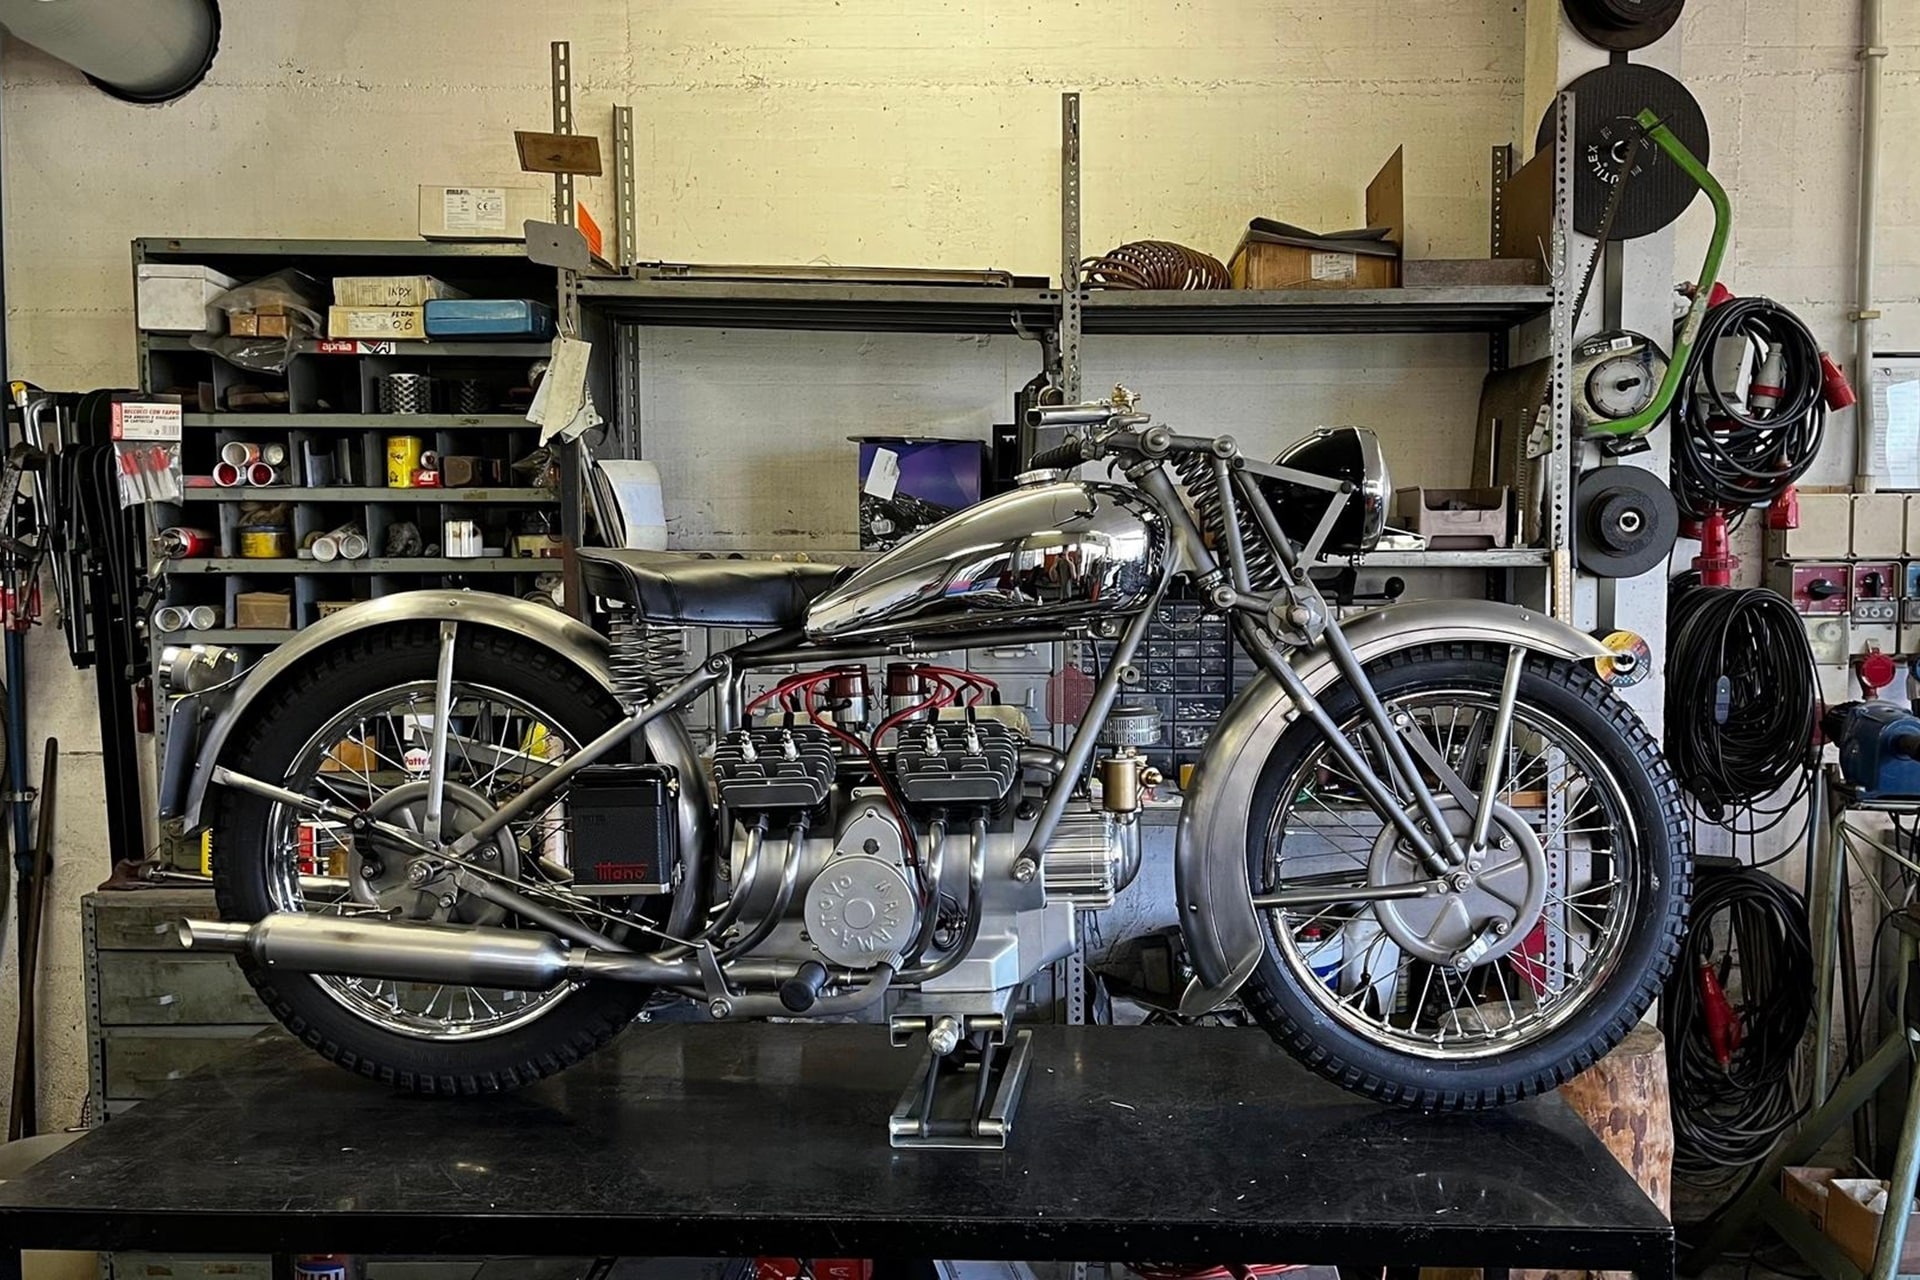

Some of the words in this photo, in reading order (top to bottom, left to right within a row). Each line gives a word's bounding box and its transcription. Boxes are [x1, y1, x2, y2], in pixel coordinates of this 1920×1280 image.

[1588, 145, 1619, 184] UTILEX
[388, 286, 412, 297] INOX
[392, 319, 413, 331] 0.6
[322, 341, 352, 352] aprilia
[404, 756, 431, 765] Patte
